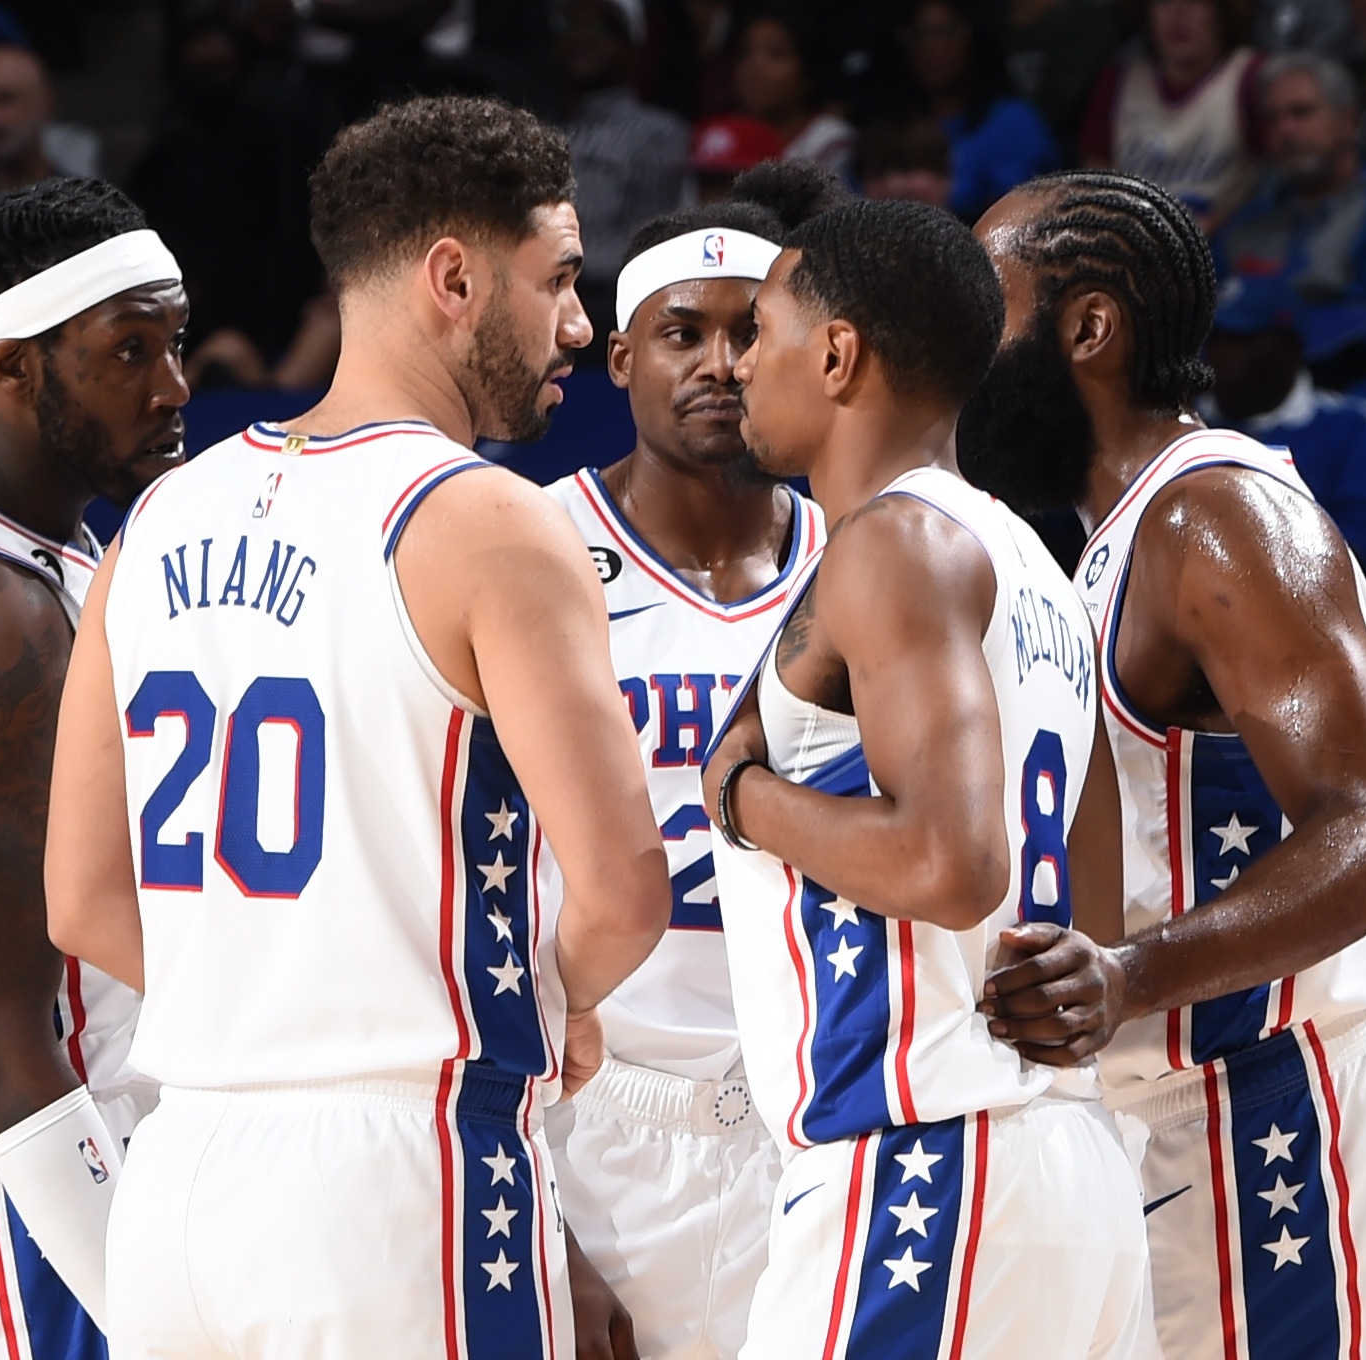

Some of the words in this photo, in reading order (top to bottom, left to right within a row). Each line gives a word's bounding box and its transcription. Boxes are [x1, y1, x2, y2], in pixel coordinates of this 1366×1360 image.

[161, 535, 316, 627] NIANG
[1011, 588, 1091, 713] MELTON
[125, 671, 325, 899] 20
[1018, 728, 1073, 928] 8
